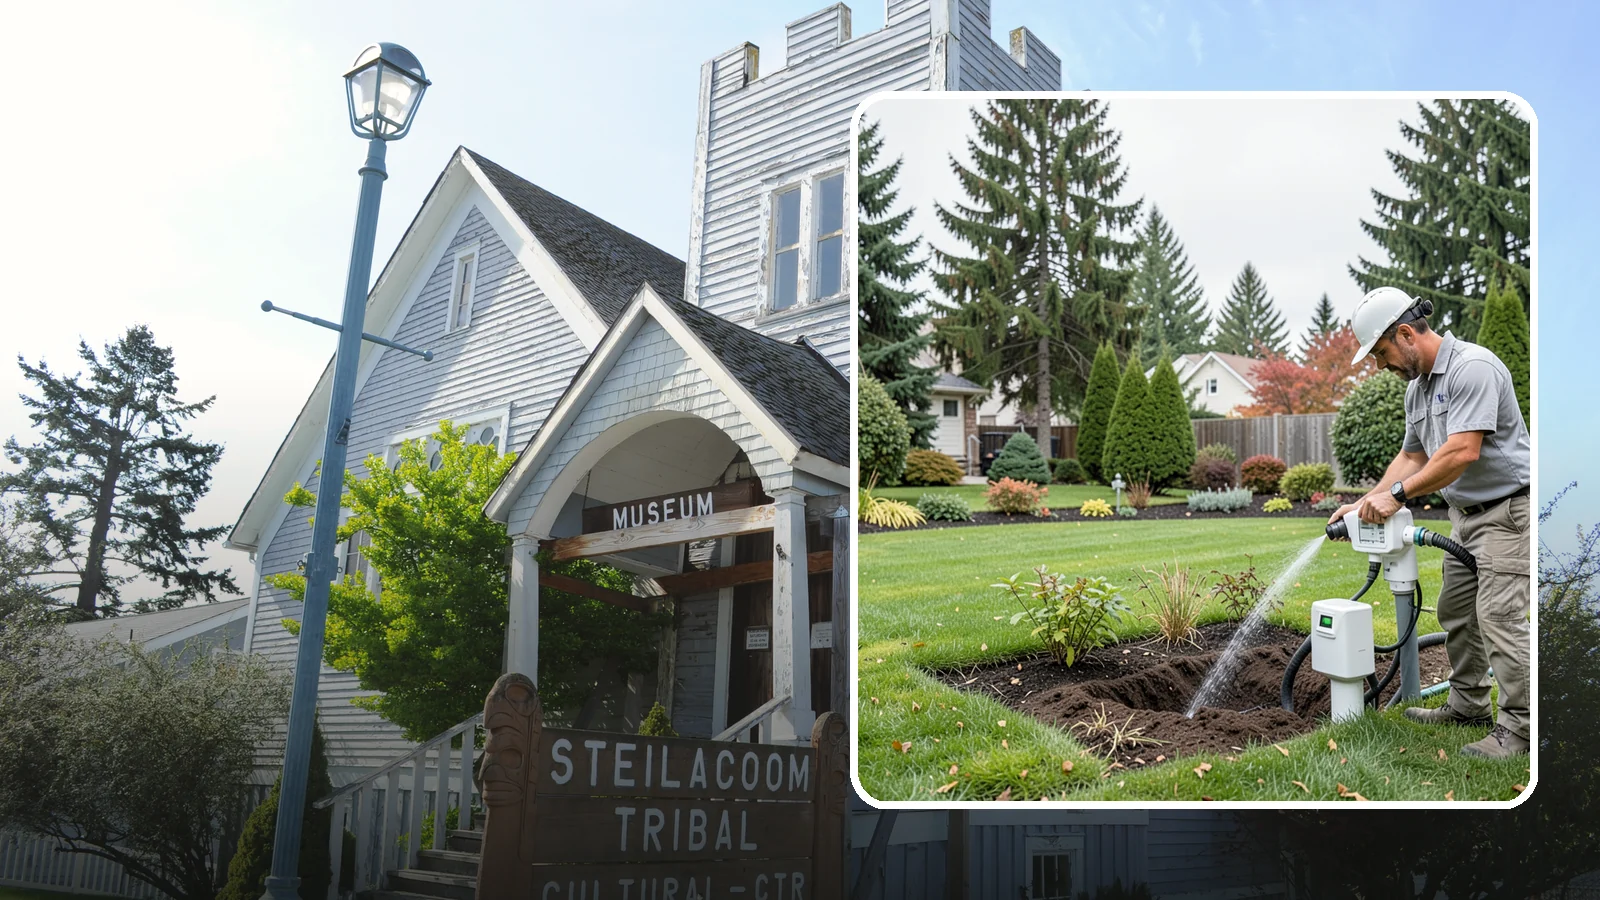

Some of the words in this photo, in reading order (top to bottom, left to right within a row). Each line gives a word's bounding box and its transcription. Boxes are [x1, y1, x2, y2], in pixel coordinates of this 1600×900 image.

[613, 491, 713, 530] MUSEUM
[551, 738, 809, 793] STEILACOOM
[614, 806, 757, 852] TRIBAL
